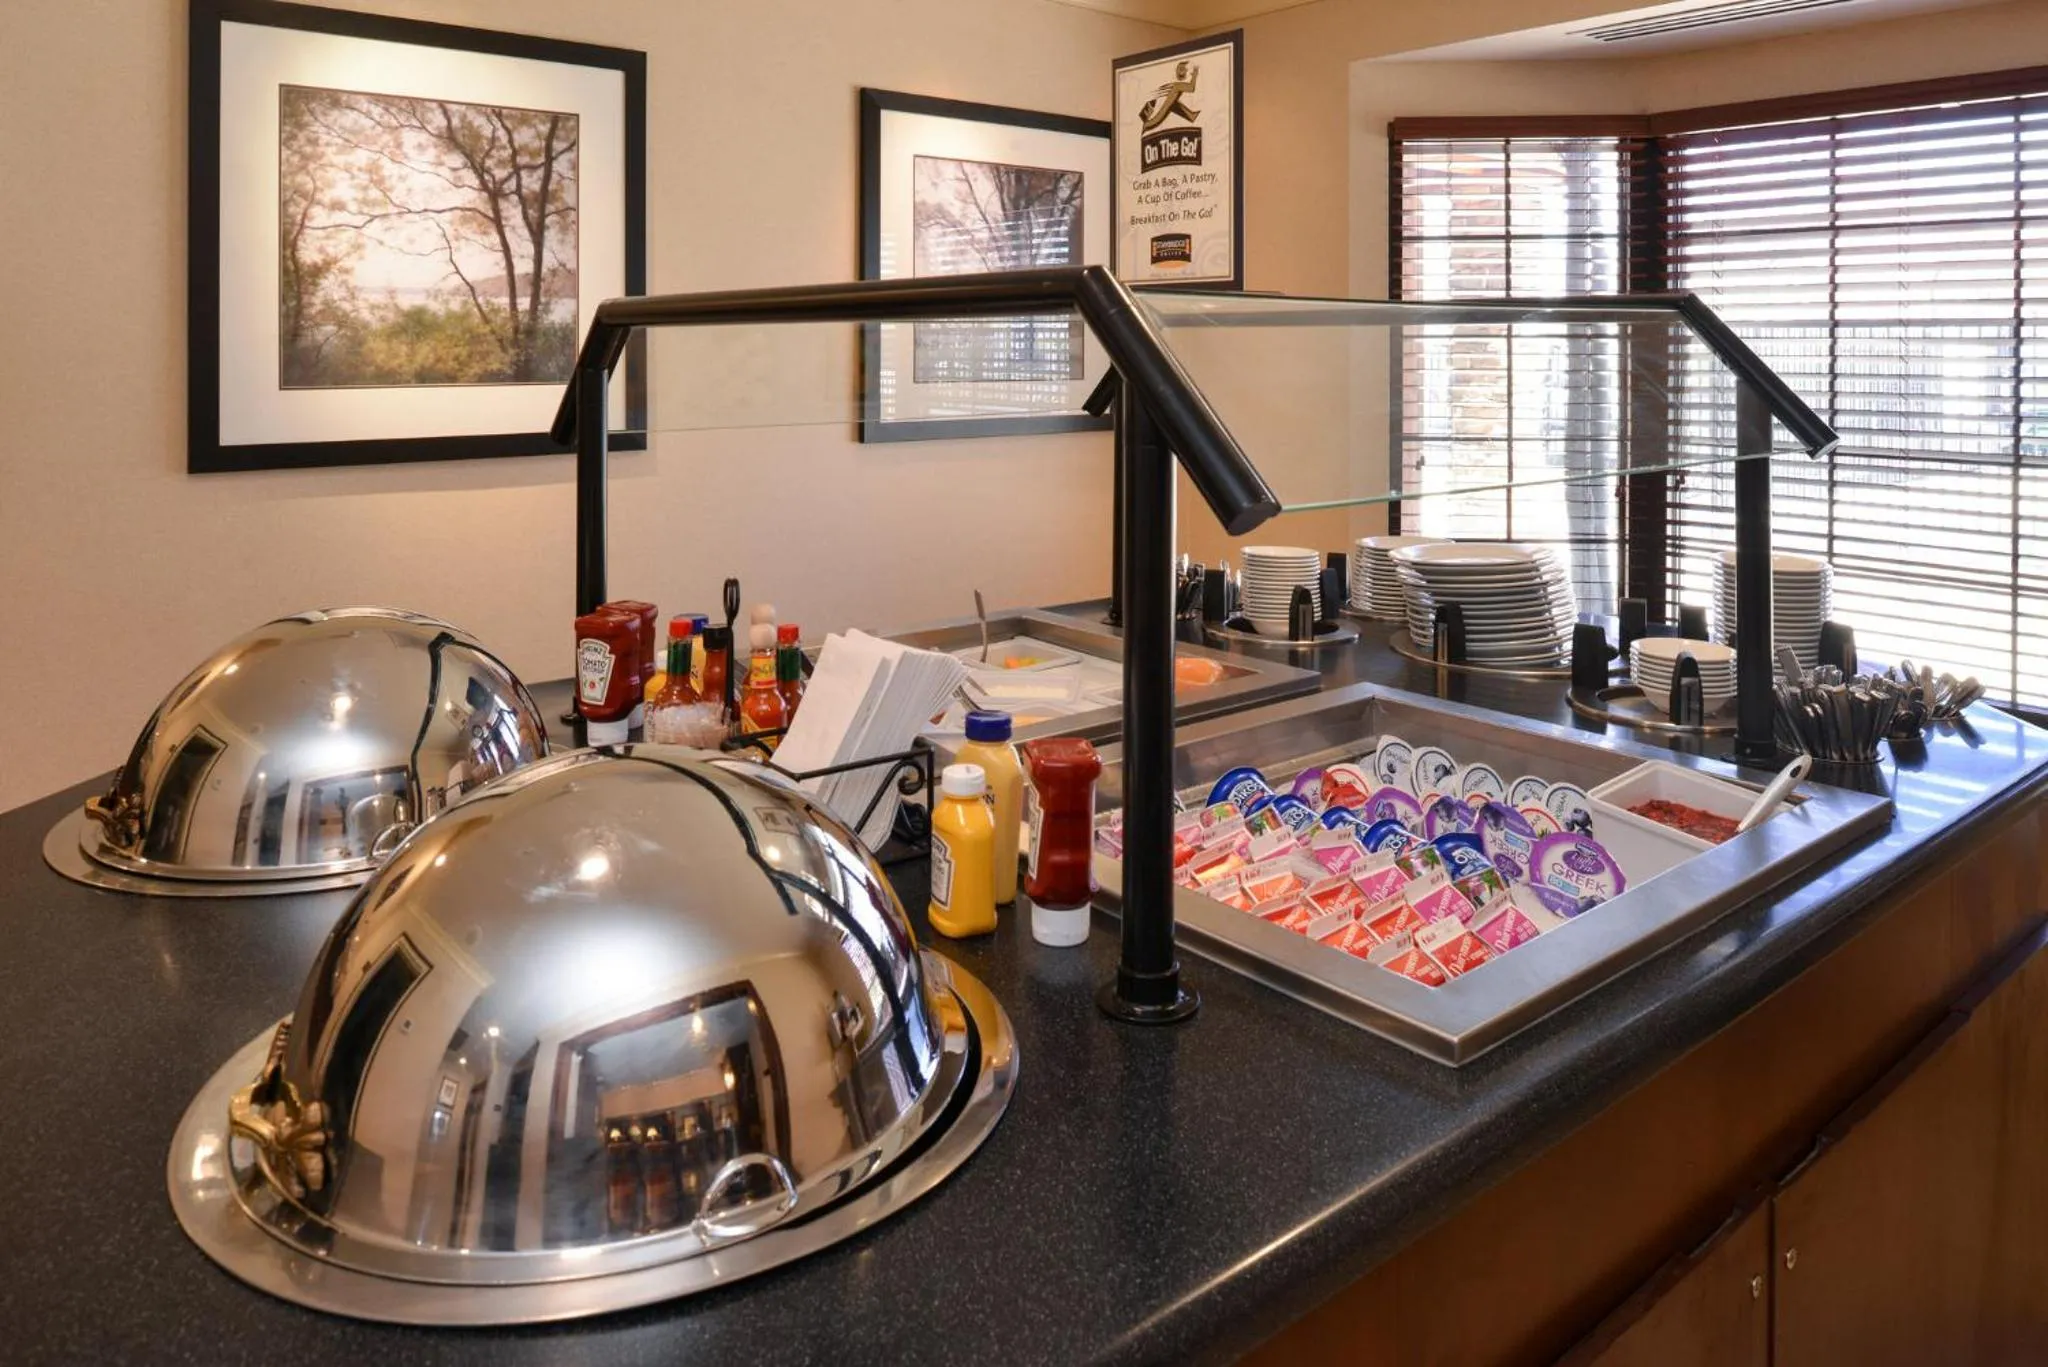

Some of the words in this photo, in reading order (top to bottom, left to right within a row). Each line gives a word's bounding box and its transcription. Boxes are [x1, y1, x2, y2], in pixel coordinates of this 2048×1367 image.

[1144, 143, 1159, 164] On
[1160, 139, 1180, 158] The
[1180, 136, 1198, 157] Go!
[1132, 179, 1152, 192] Grab
[1154, 178, 1160, 189] A
[1161, 176, 1178, 189] Bag,
[1181, 174, 1189, 185] A
[1190, 171, 1218, 185] Pastry,
[1136, 194, 1144, 205] A
[1145, 192, 1161, 206] Cup
[1163, 190, 1173, 202] Of
[1130, 211, 1166, 226] Breakfast
[1168, 209, 1180, 222] On
[1182, 208, 1197, 221] The
[1551, 862, 1608, 895] GREEK
